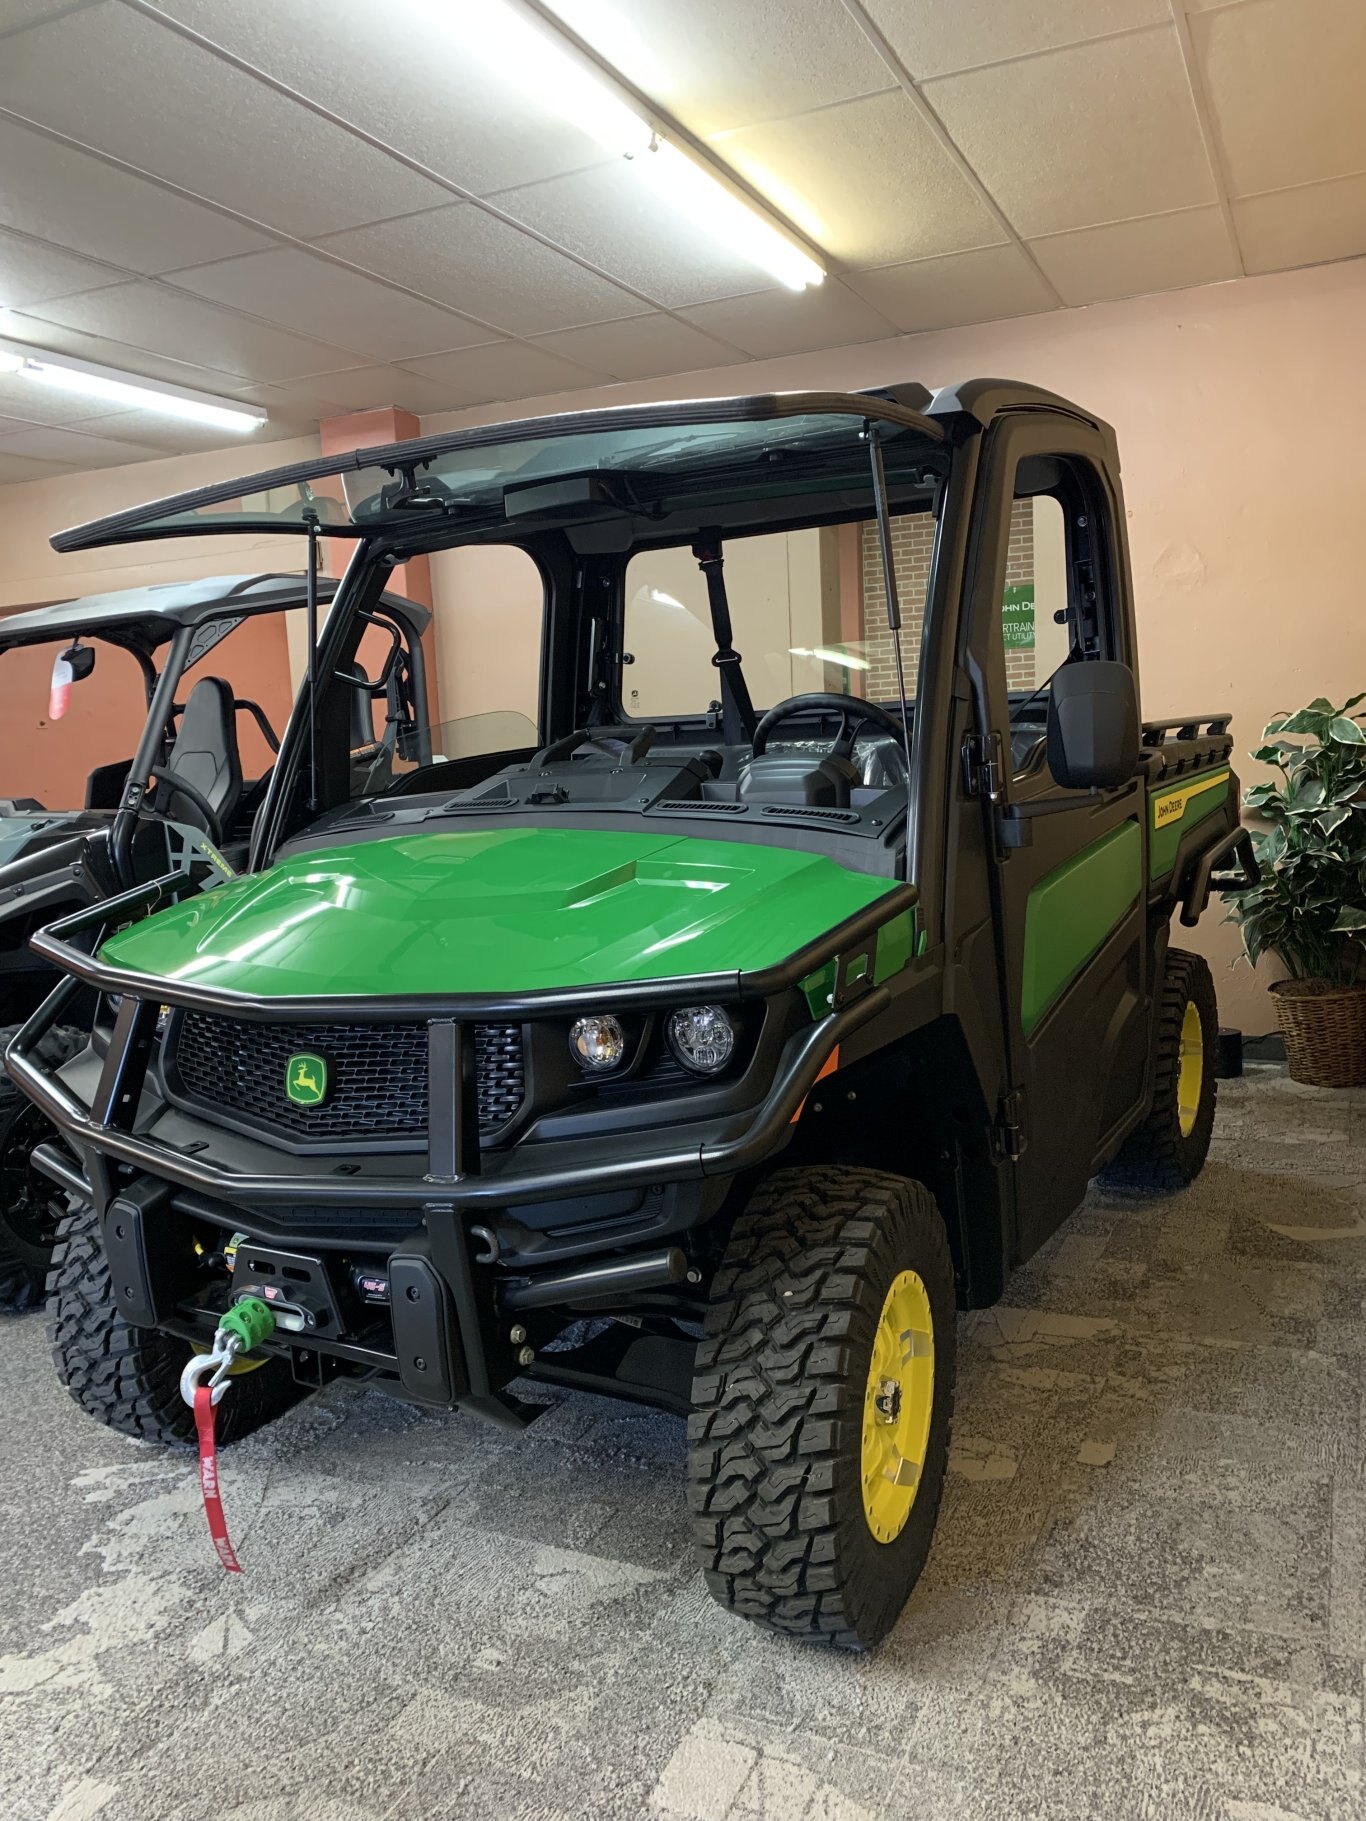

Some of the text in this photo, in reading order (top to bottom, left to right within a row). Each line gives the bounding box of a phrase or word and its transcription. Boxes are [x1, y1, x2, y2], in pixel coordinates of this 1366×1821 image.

[1002, 621, 1035, 633] RTRAIN
[1158, 798, 1182, 818] JOHN DEERE
[200, 842, 232, 878] XTREME
[202, 1455, 217, 1499] WARN
[214, 1537, 237, 1567] WARN
